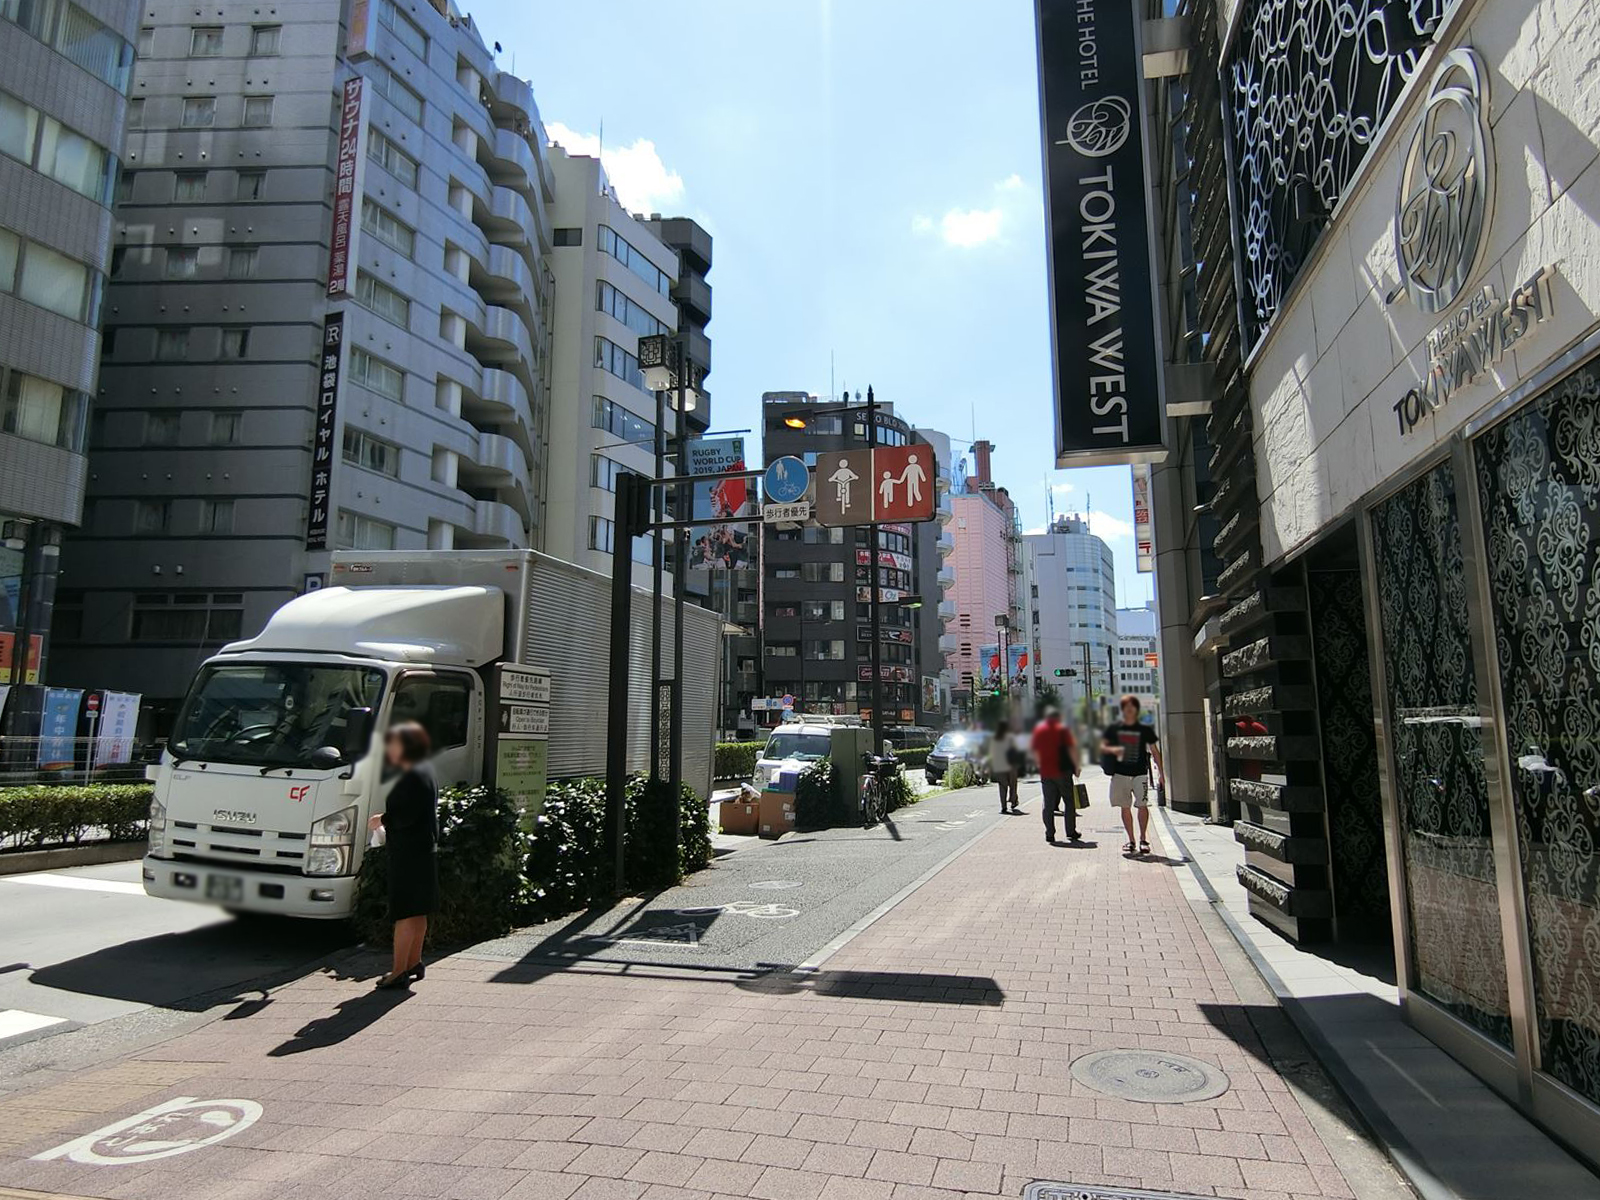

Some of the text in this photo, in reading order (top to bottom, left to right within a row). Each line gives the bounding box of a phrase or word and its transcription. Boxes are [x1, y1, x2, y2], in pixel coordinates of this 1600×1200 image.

[1076, 0, 1099, 91] HE HOTEL
[337, 81, 363, 196] サウナ24時間
[1078, 164, 1130, 444] TOKIWA WEST
[1470, 264, 1553, 376] WEST
[856, 411, 882, 424] SEO
[692, 449, 721, 457] RUGBY
[694, 457, 725, 466] WORLD
[766, 507, 807, 519] 歩行者優先
[290, 785, 310, 802] CF
[213, 809, 257, 824] ISUZU
